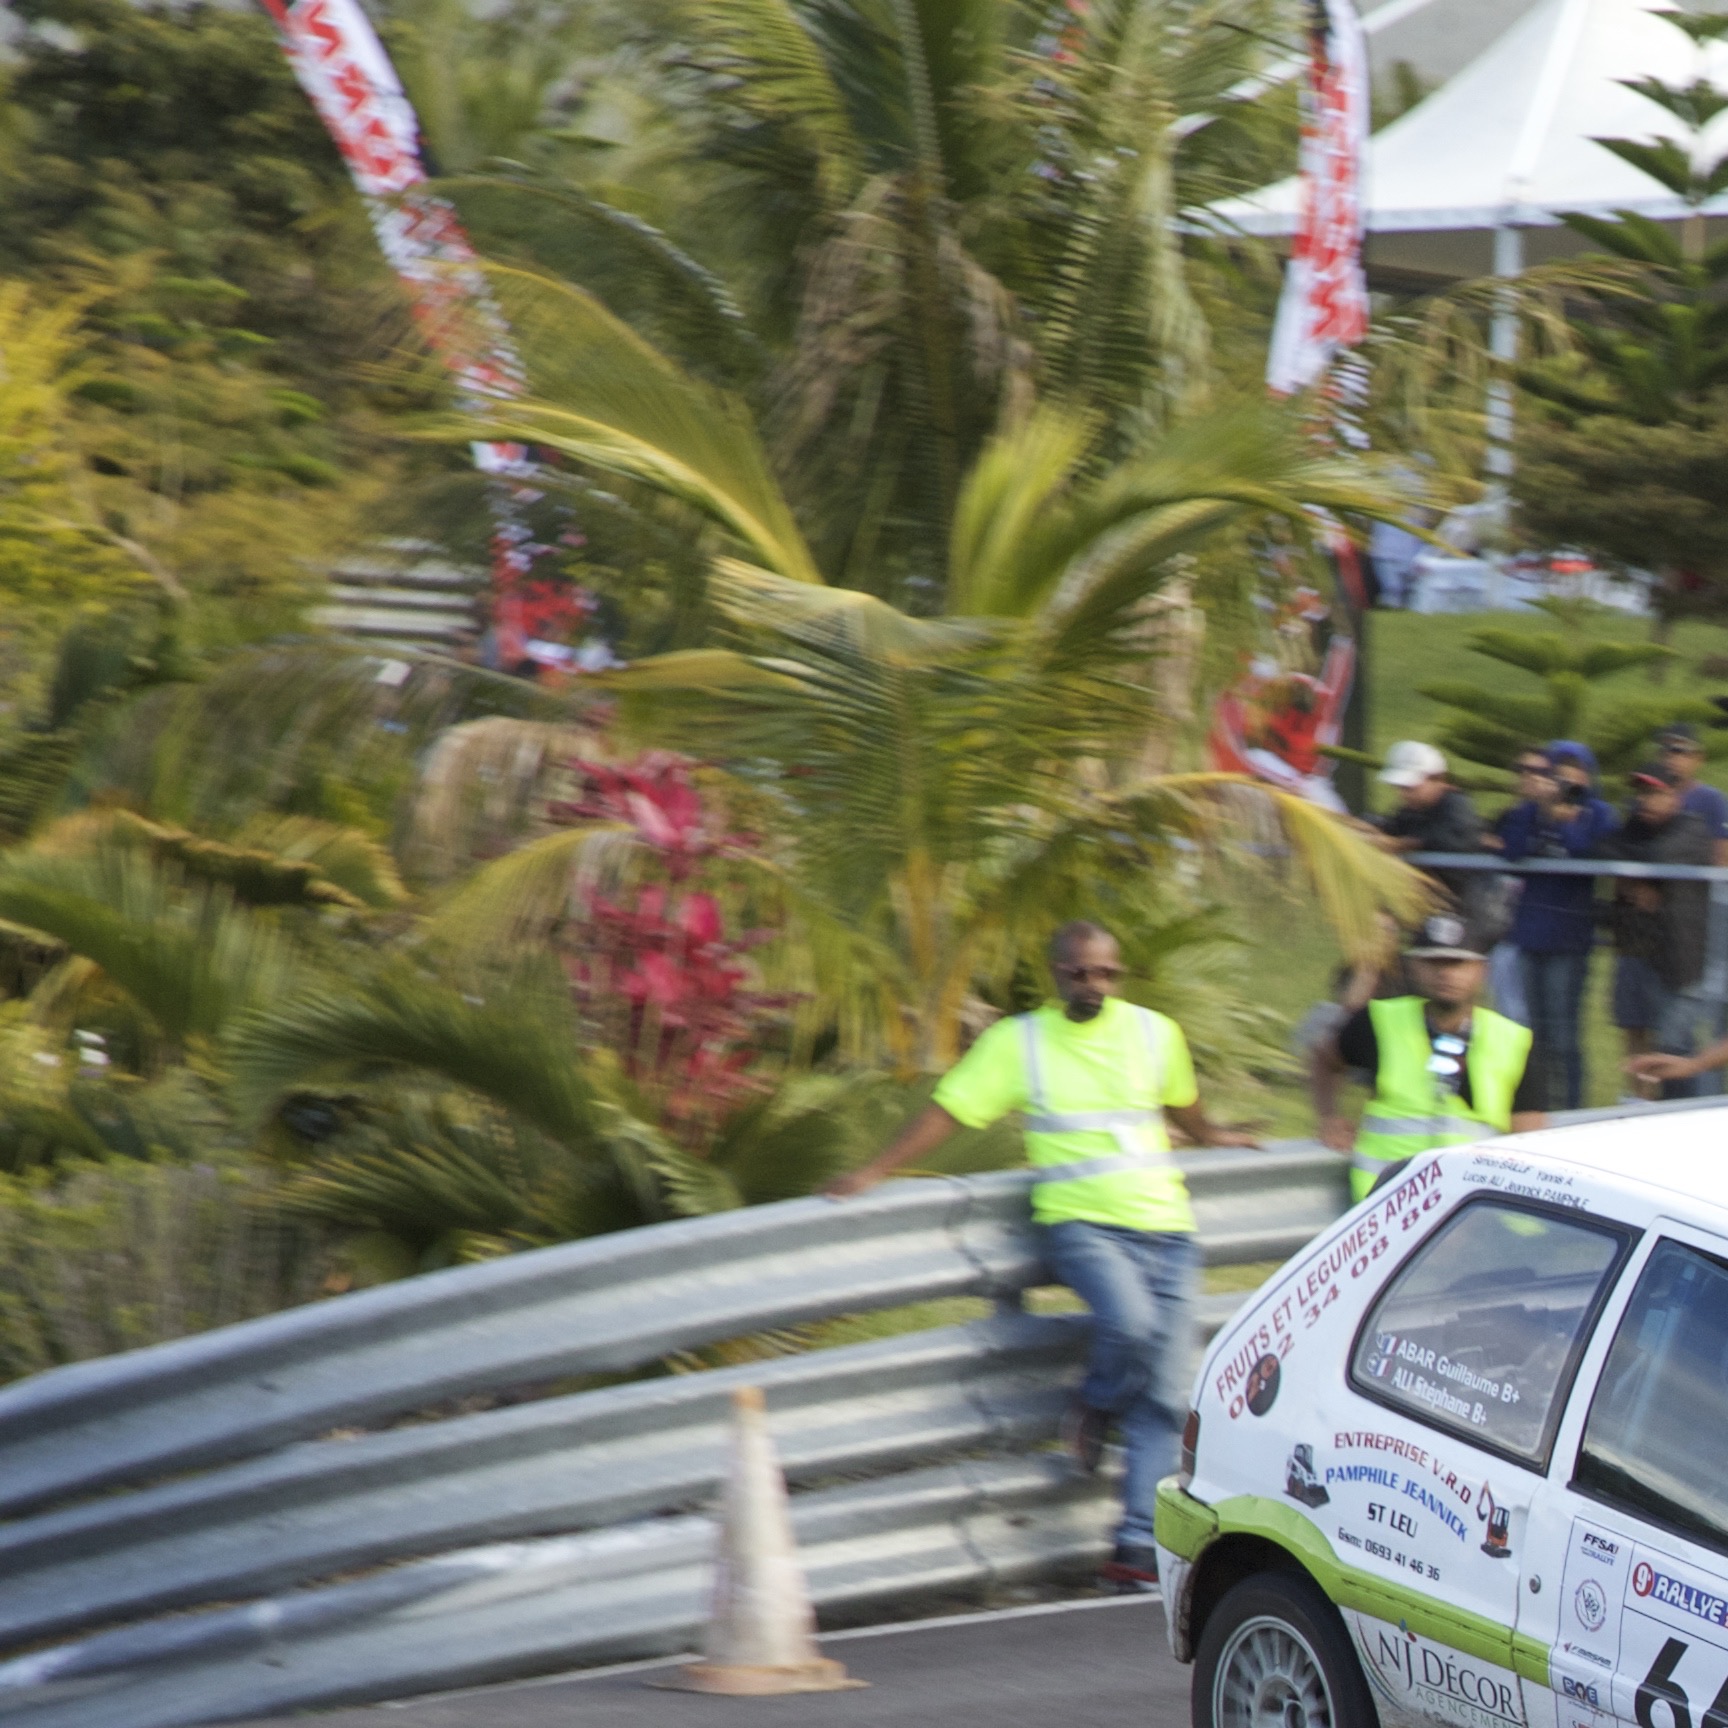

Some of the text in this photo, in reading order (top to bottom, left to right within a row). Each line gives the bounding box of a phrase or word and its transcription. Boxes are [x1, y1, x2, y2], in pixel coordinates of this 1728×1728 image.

[1216, 1325, 1270, 1402] FRUITS
[1272, 1297, 1293, 1333] ET
[1297, 1215, 1379, 1306] LEGUMES
[1306, 1285, 1340, 1329] 34
[1391, 1367, 1411, 1392] ALI
[1414, 1375, 1469, 1418] Stéphane
[1397, 1340, 1521, 1405] ABAR Guillaume B+
[1335, 1432, 1428, 1468] ENTREPRISE
[1326, 1465, 1468, 1543] PAMPHILE JEANNICK
[1367, 1502, 1419, 1538] ST LEU
[1365, 1538, 1392, 1561] 0693
[1394, 1551, 1406, 1567] 41
[1409, 1557, 1424, 1574] 46
[1426, 1564, 1441, 1581] 36
[1654, 1576, 1725, 1622] RALLYE
[1421, 1646, 1518, 1719] DÉCOR
